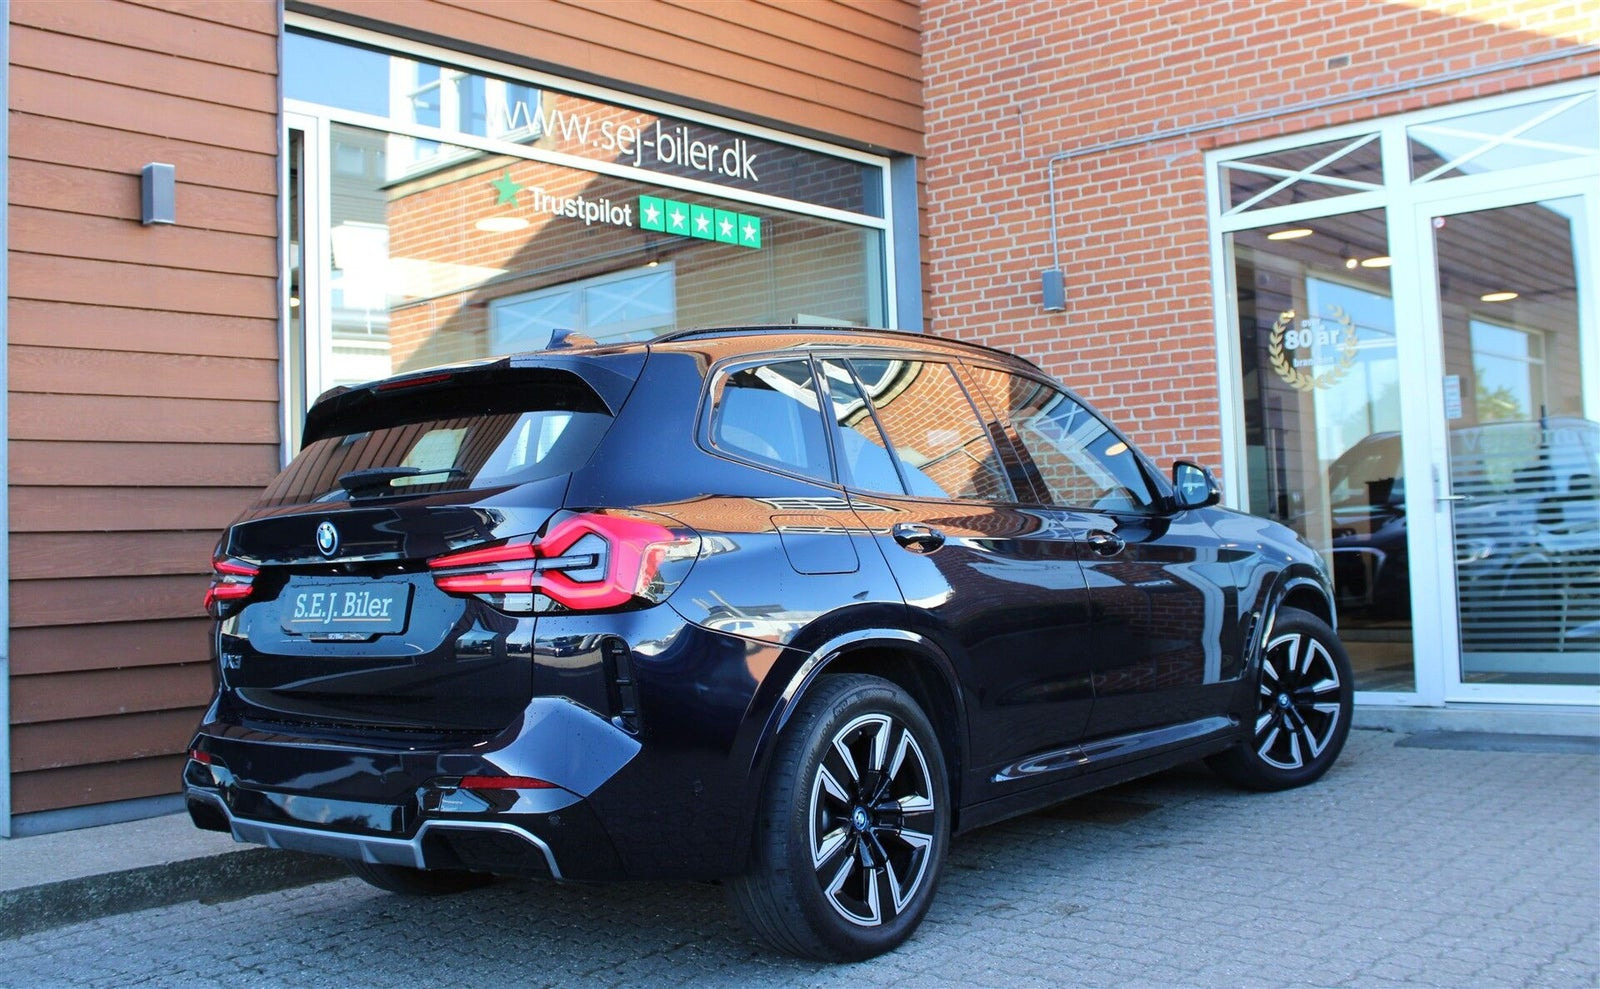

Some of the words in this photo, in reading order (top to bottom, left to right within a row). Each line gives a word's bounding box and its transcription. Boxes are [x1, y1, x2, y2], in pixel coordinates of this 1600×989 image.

[490, 100, 759, 182] www.sej-biler.dk
[528, 186, 633, 227] Trustpilot
[1284, 329, 1313, 350] 80
[1320, 325, 1340, 346] år
[295, 593, 338, 624] S.E.J.
[342, 592, 393, 617] Biler
